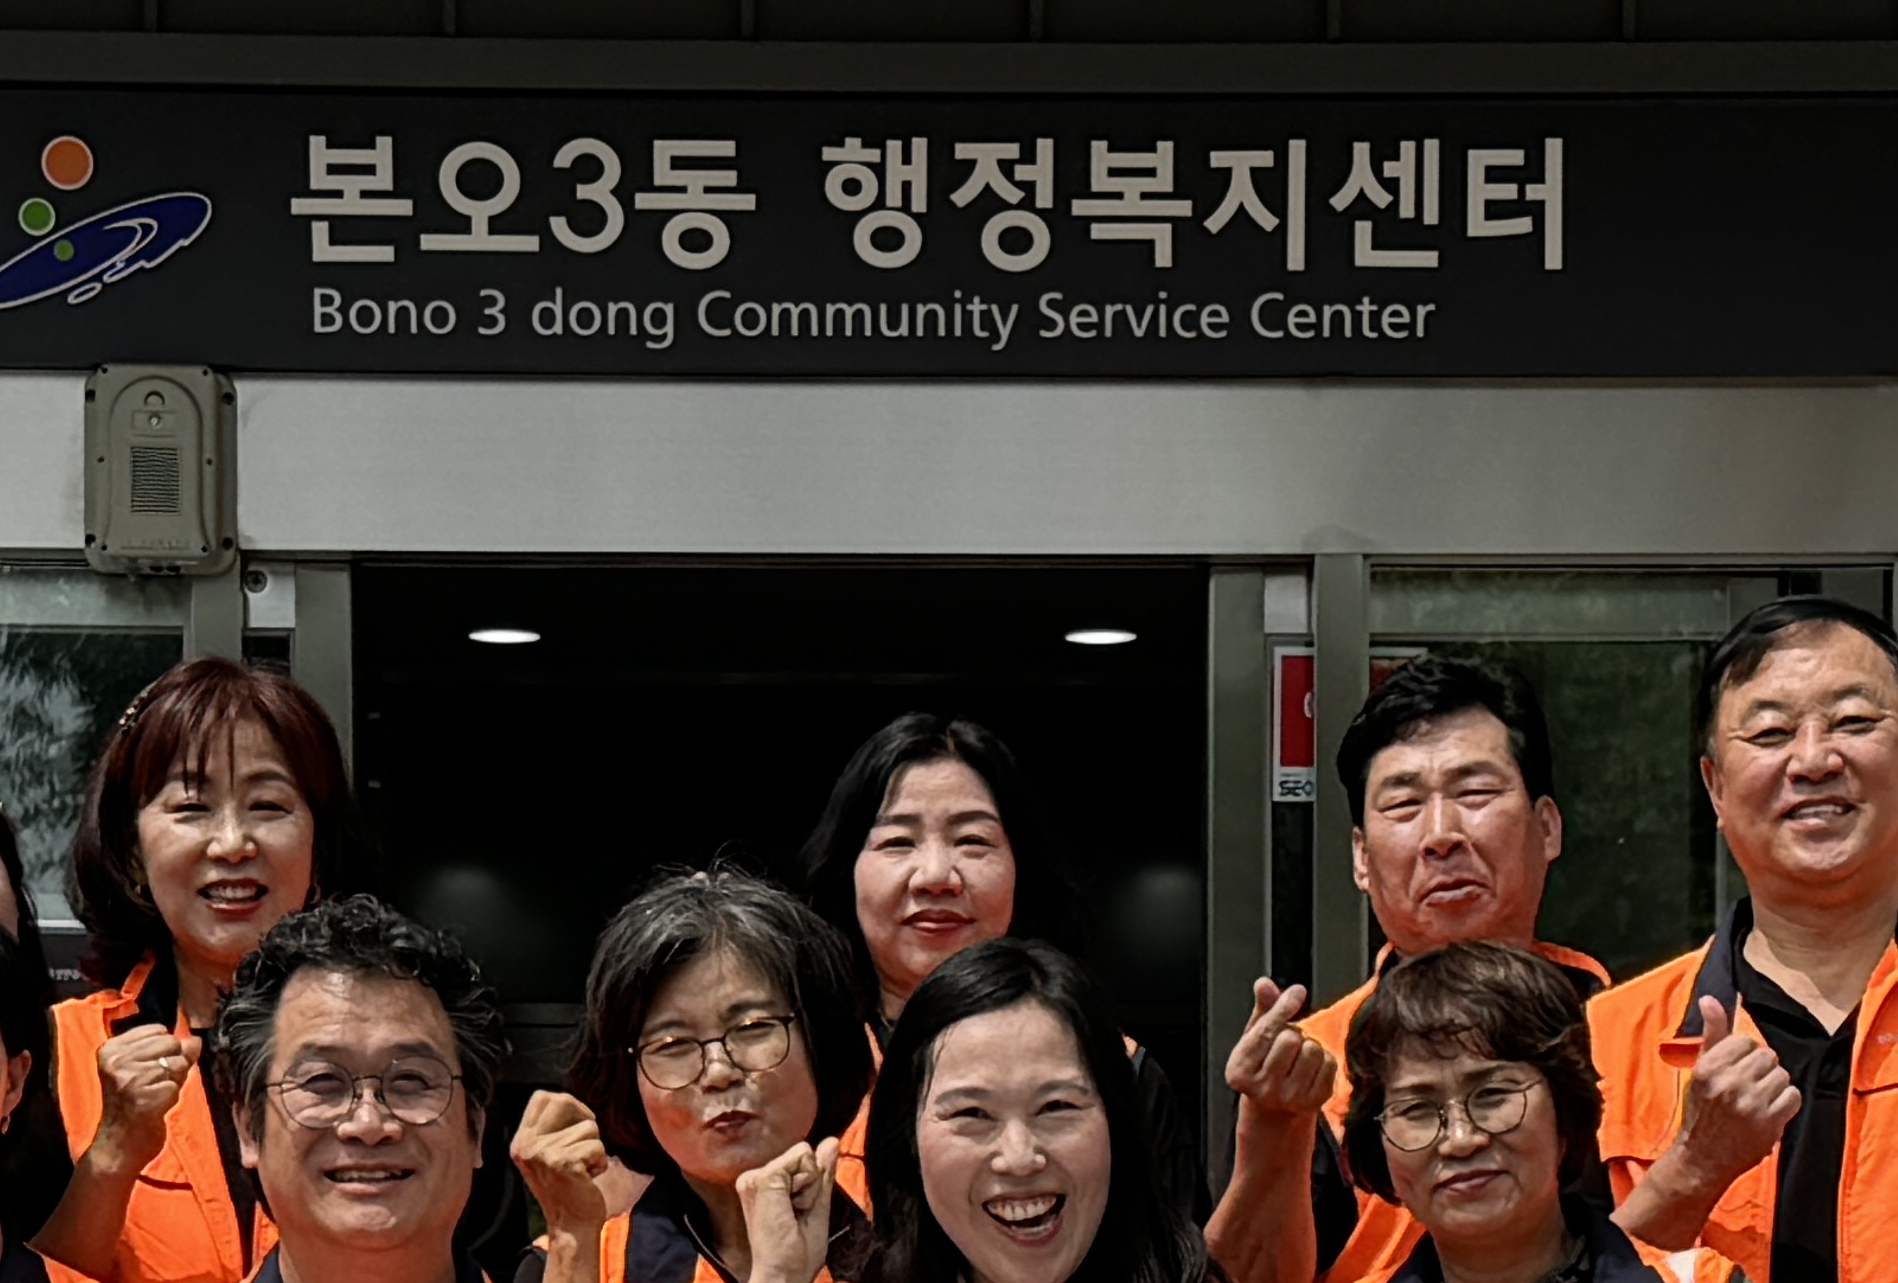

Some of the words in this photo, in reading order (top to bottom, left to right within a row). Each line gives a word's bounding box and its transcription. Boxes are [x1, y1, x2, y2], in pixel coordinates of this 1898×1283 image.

[290, 135, 757, 270] 본오3동
[821, 136, 1563, 272] 행정복지센터
[313, 287, 457, 335] Bono
[477, 288, 506, 335] 3
[531, 286, 674, 349] dong
[697, 289, 1019, 351] Community
[1039, 291, 1230, 339] Service
[1250, 292, 1436, 339] Center
